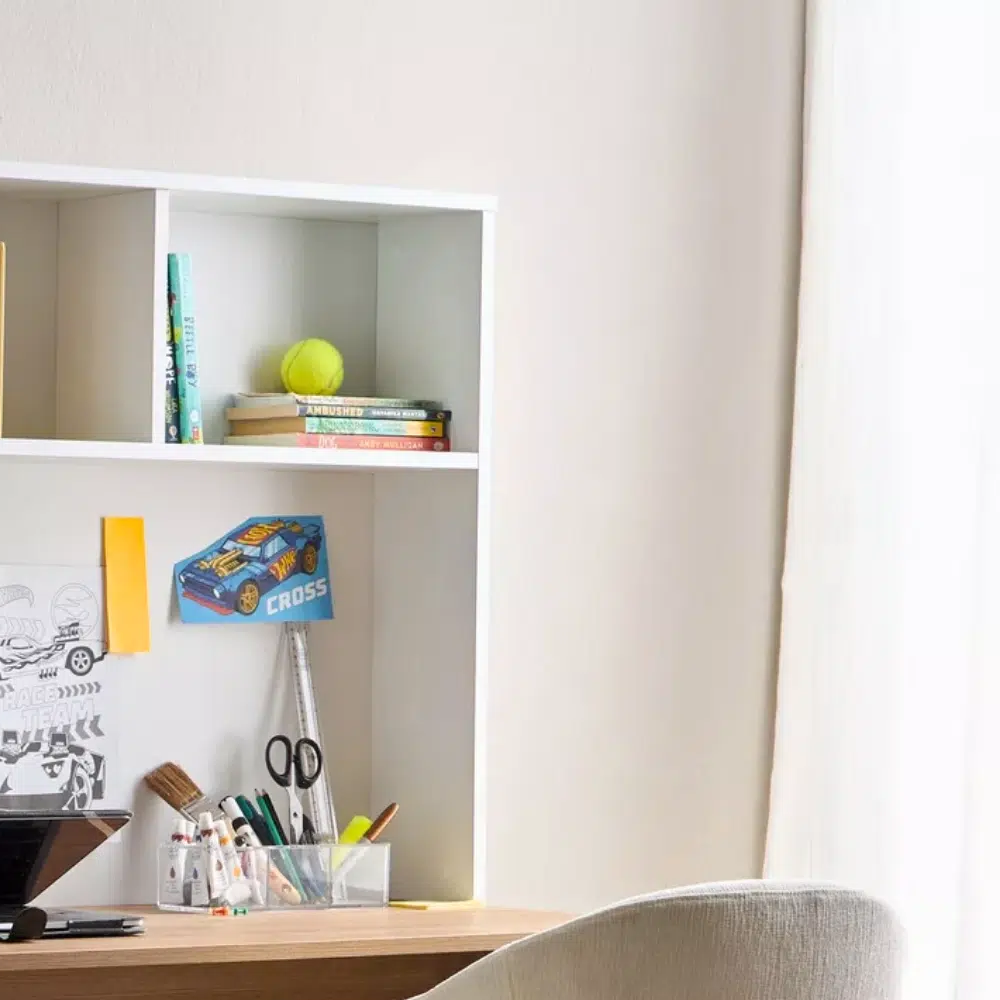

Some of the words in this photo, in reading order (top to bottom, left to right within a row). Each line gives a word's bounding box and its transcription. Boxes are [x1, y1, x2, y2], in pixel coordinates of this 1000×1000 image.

[186, 363, 197, 388] BOY
[305, 405, 364, 417] AMBUSHED
[266, 578, 327, 616] CROSS
[2, 683, 58, 711] RACE
[22, 698, 95, 732] TEAM
